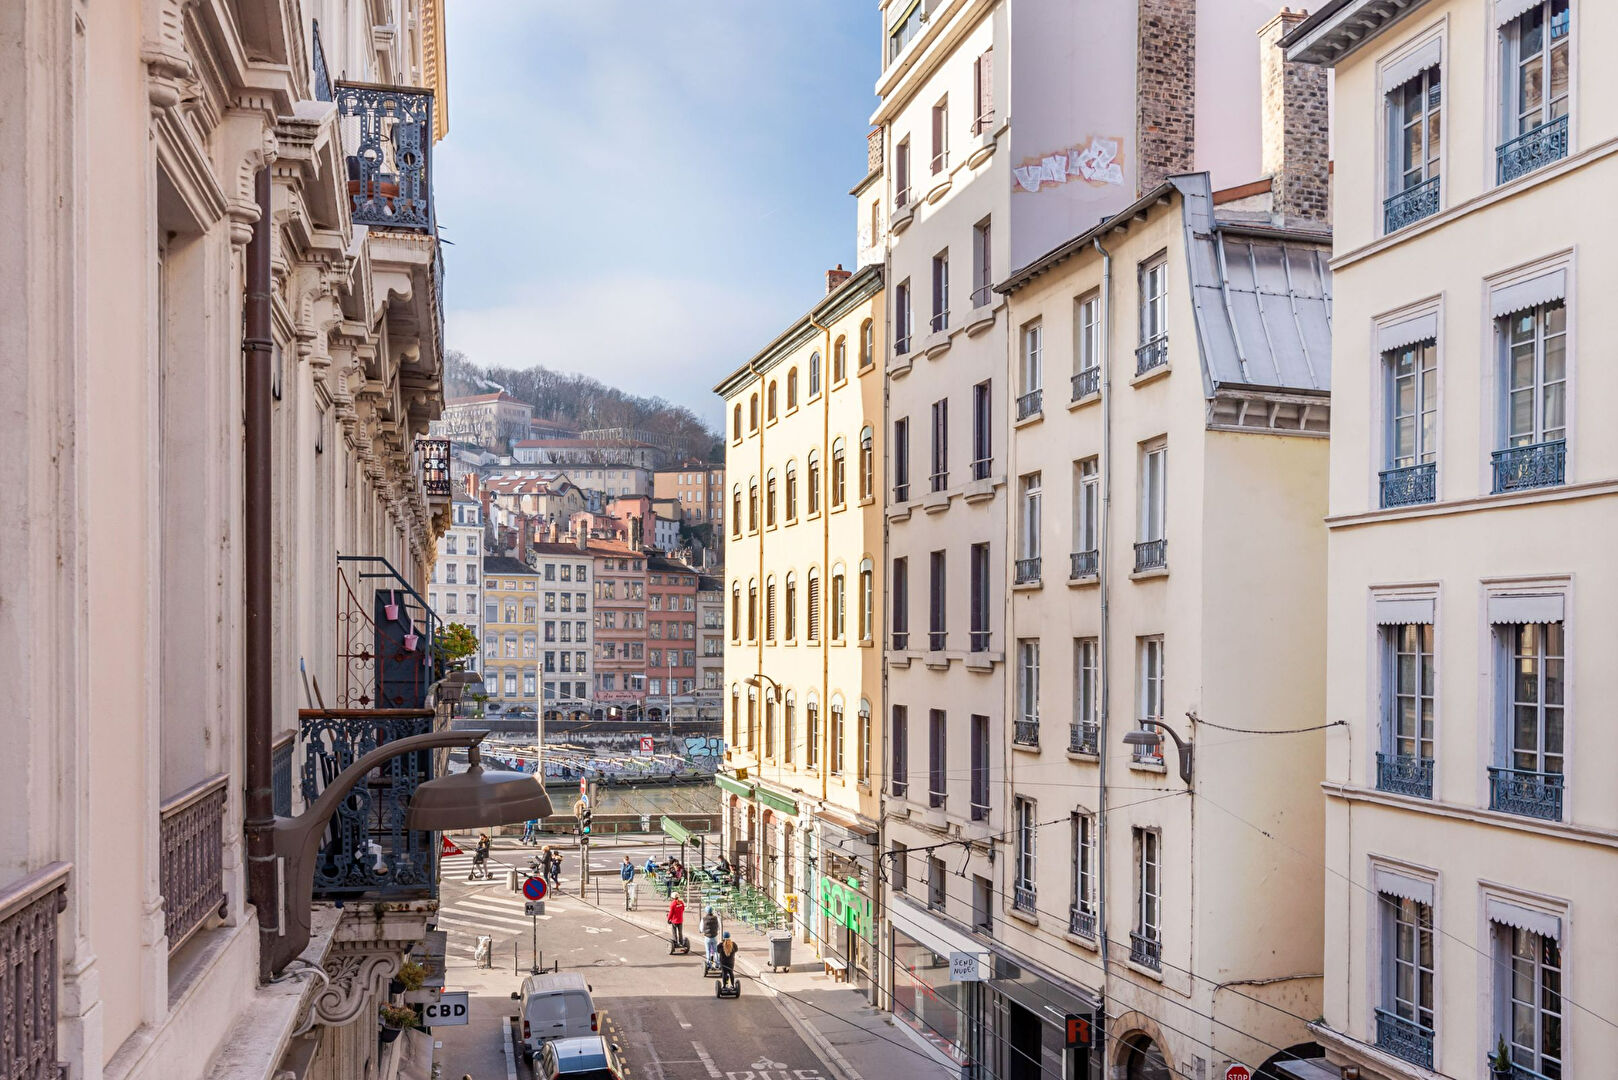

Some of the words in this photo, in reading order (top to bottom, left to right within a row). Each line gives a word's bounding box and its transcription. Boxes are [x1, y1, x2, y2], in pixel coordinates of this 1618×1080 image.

[954, 958, 973, 966] SEND
[426, 1004, 466, 1018] CBD
[1067, 1019, 1089, 1043] R
